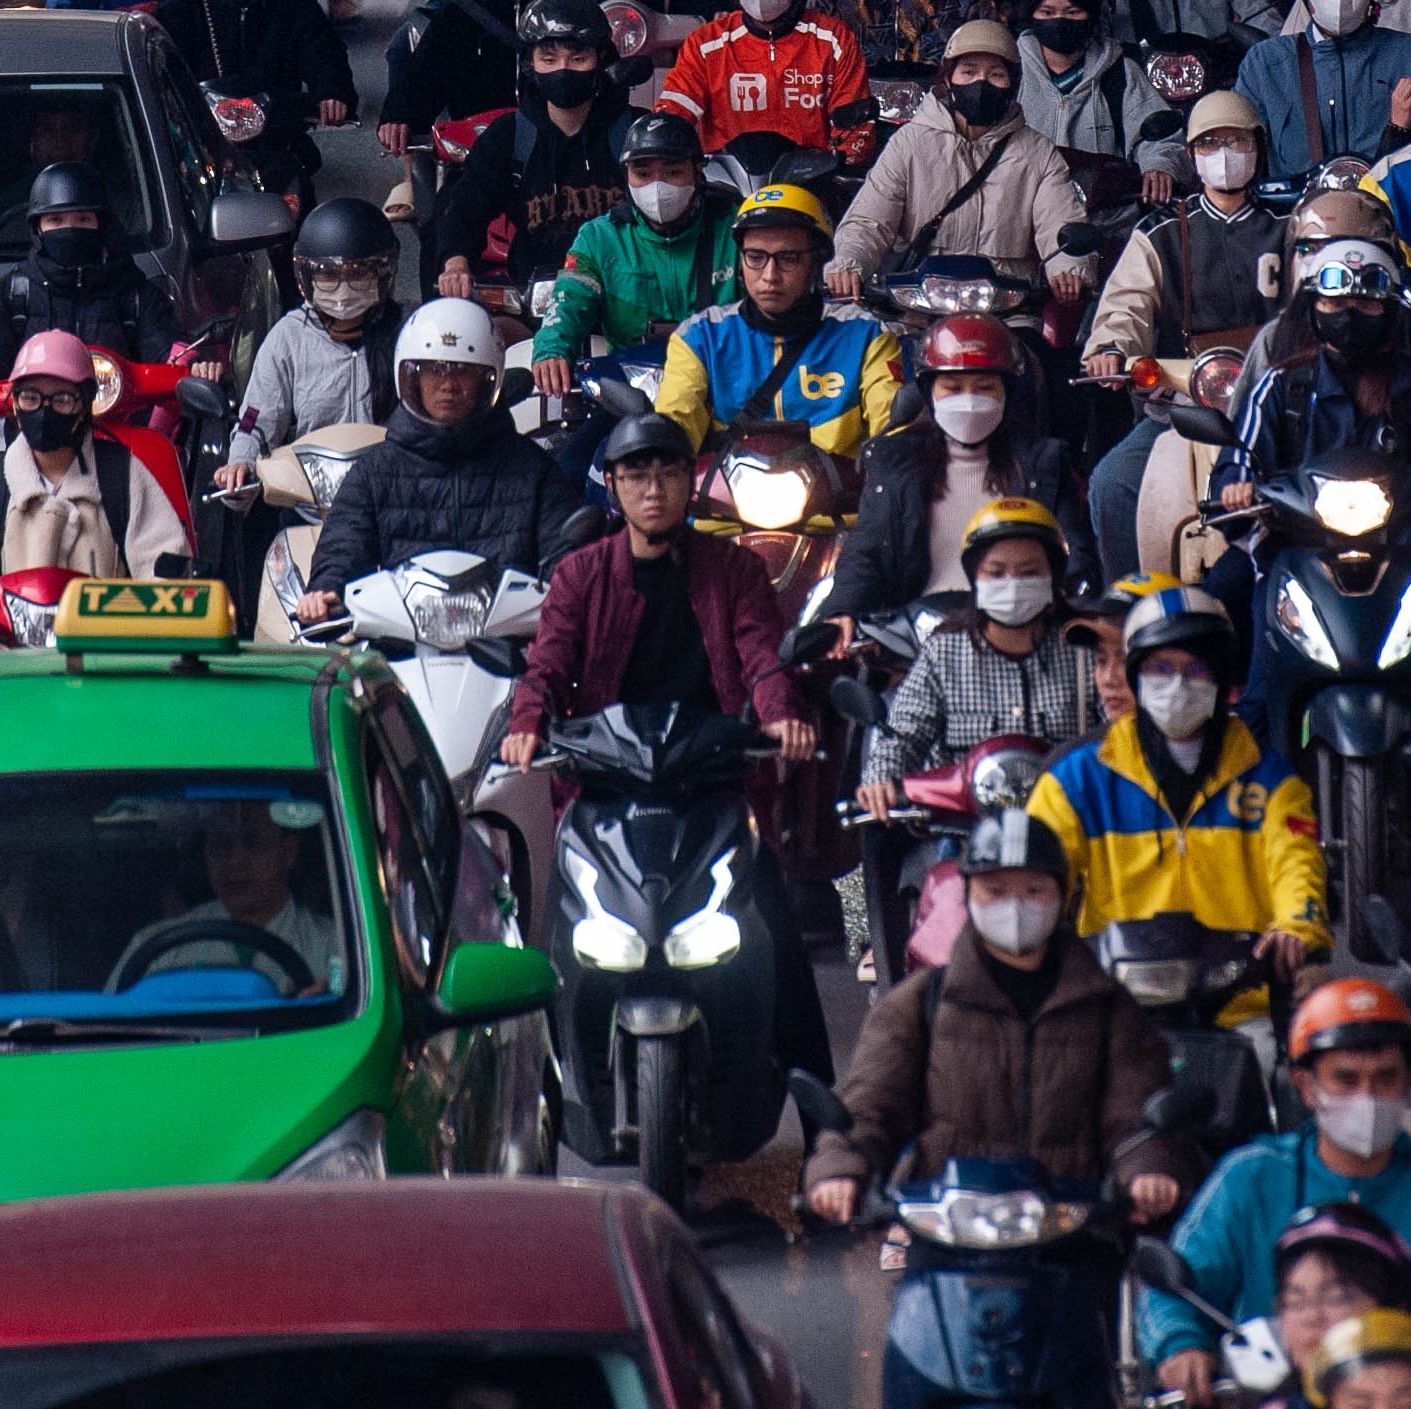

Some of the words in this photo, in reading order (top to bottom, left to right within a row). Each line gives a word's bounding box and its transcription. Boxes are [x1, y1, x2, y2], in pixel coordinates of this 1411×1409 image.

[754, 190, 784, 203] be
[710, 264, 735, 286] rab
[1257, 252, 1281, 299] C
[798, 364, 846, 401] be
